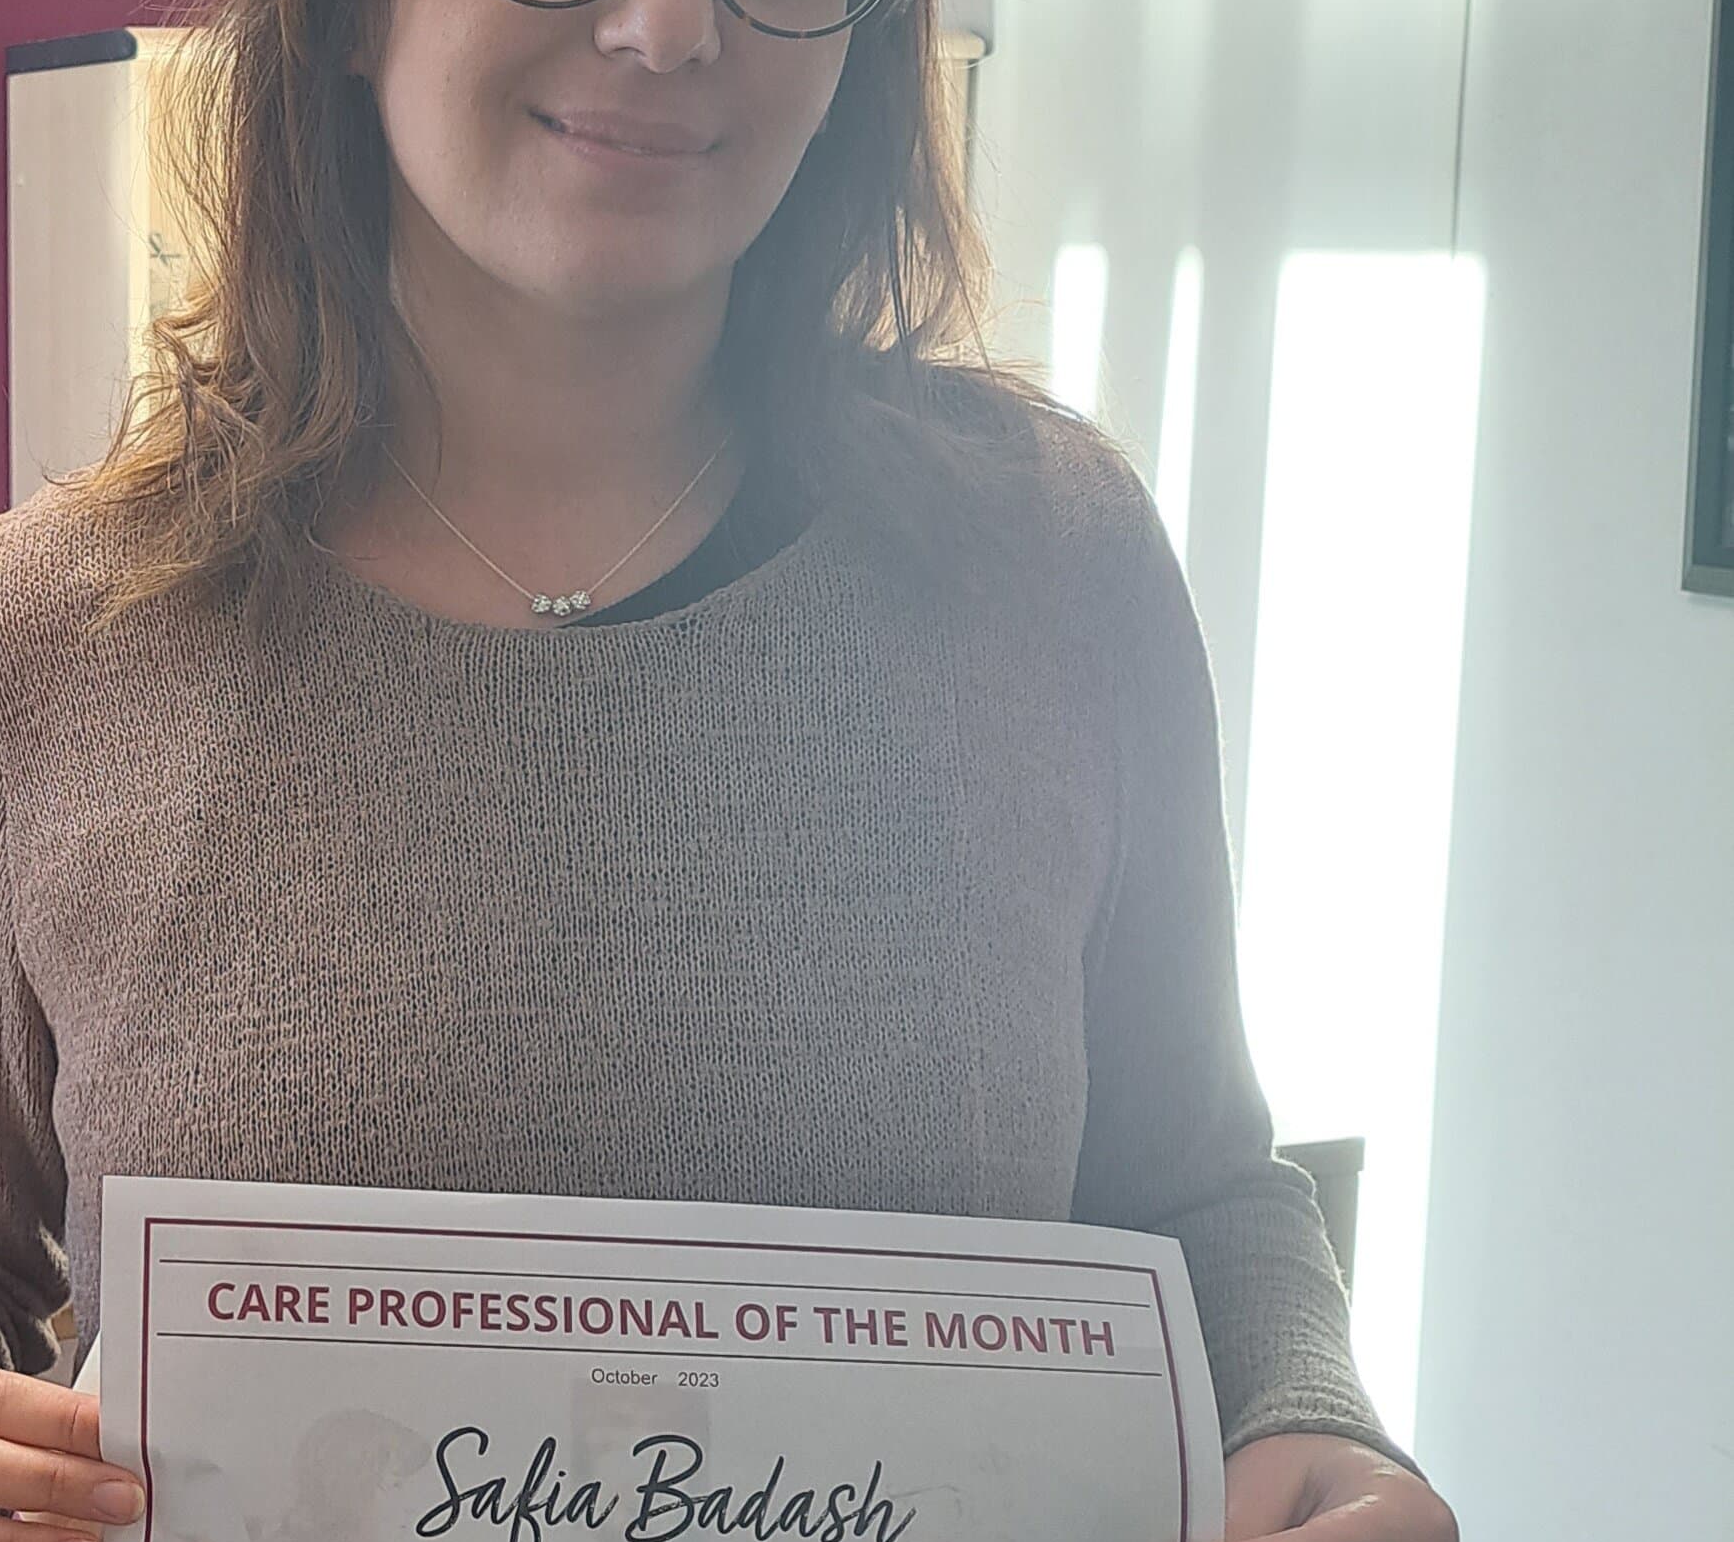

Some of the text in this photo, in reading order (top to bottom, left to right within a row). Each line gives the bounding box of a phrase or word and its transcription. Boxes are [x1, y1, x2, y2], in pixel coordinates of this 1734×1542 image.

[206, 1281, 1115, 1357] CARE PROFESSIONAL OF THE MONTH
[591, 1368, 720, 1389] October 2023
